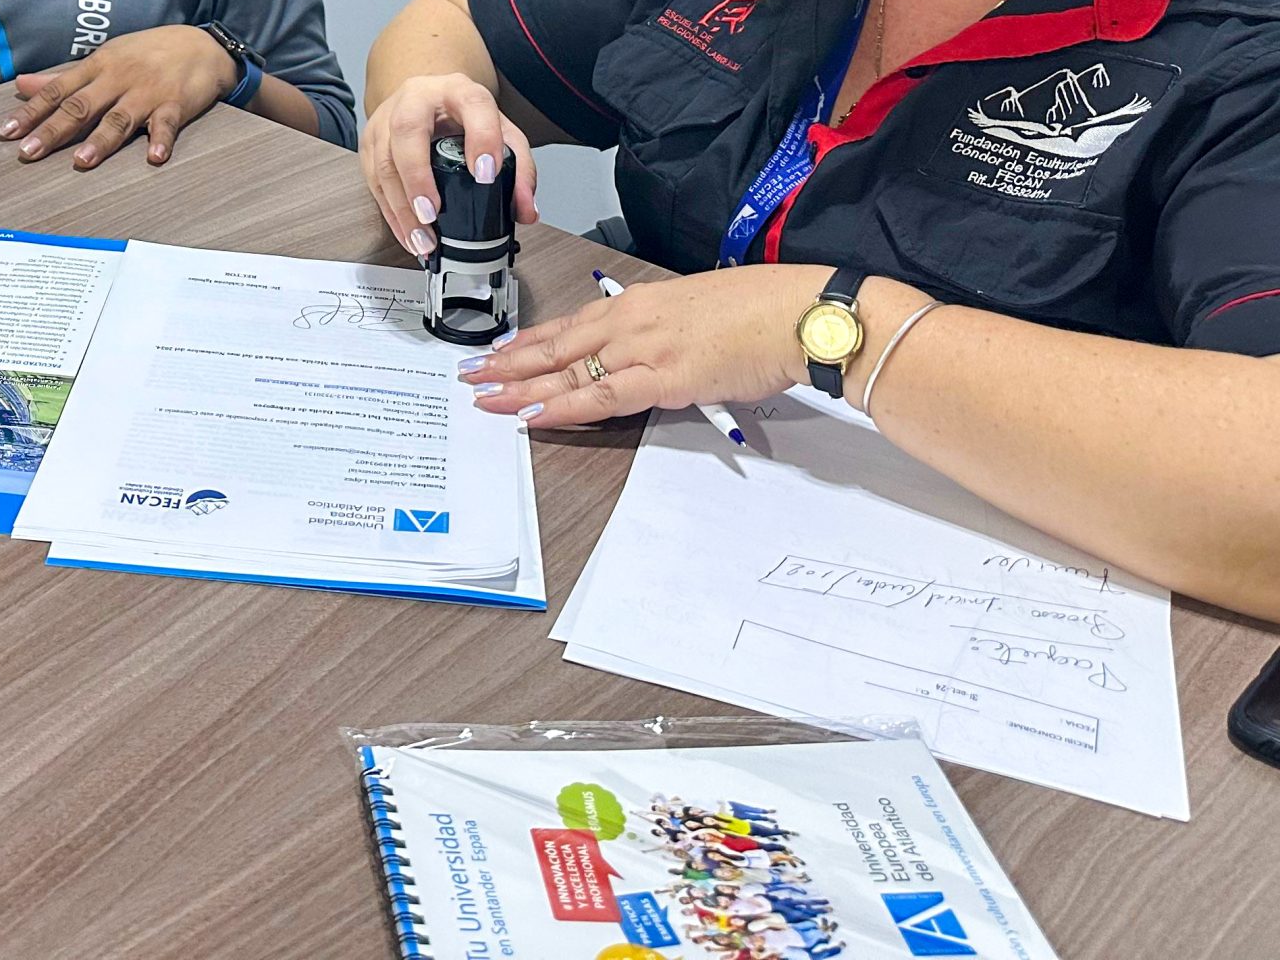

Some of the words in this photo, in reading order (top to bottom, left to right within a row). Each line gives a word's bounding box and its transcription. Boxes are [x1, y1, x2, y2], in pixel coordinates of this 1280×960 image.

[664, 9, 700, 34] ESCUELA
[700, 31, 714, 44] DE
[950, 128, 1021, 160] Fundación
[951, 143, 1003, 166] Cóndor
[1005, 159, 1023, 173] de
[1027, 163, 1051, 179] Los
[753, 174, 783, 202] FECAN
[995, 169, 1044, 189] FECAN
[22, 360, 62, 369] FACULTAD
[343, 476, 368, 484] López
[369, 478, 407, 487] Alejandra
[409, 482, 446, 490] Nombre:
[418, 473, 446, 481] Cargo:
[120, 493, 181, 509] FECAN
[307, 500, 363, 512] Atlántico
[330, 511, 384, 522] Europea
[308, 517, 384, 530] Universidad
[1065, 719, 1095, 733] FECHA
[911, 775, 940, 808] Europa
[582, 791, 601, 832] ERASMUS
[877, 797, 921, 856] Atlántico
[932, 810, 946, 824] en
[463, 819, 489, 862] España
[832, 802, 889, 883] Universidad
[868, 822, 911, 882] Europea
[940, 824, 985, 886] universitaria
[429, 812, 481, 932] Universidad
[544, 840, 571, 903] INNOVACIÓN
[562, 843, 586, 900] EXCELENCIA
[577, 843, 605, 909] PROFESIONAL
[915, 860, 934, 882] del
[477, 869, 509, 935] Santander
[979, 887, 1008, 926] cultura
[497, 939, 514, 956] en
